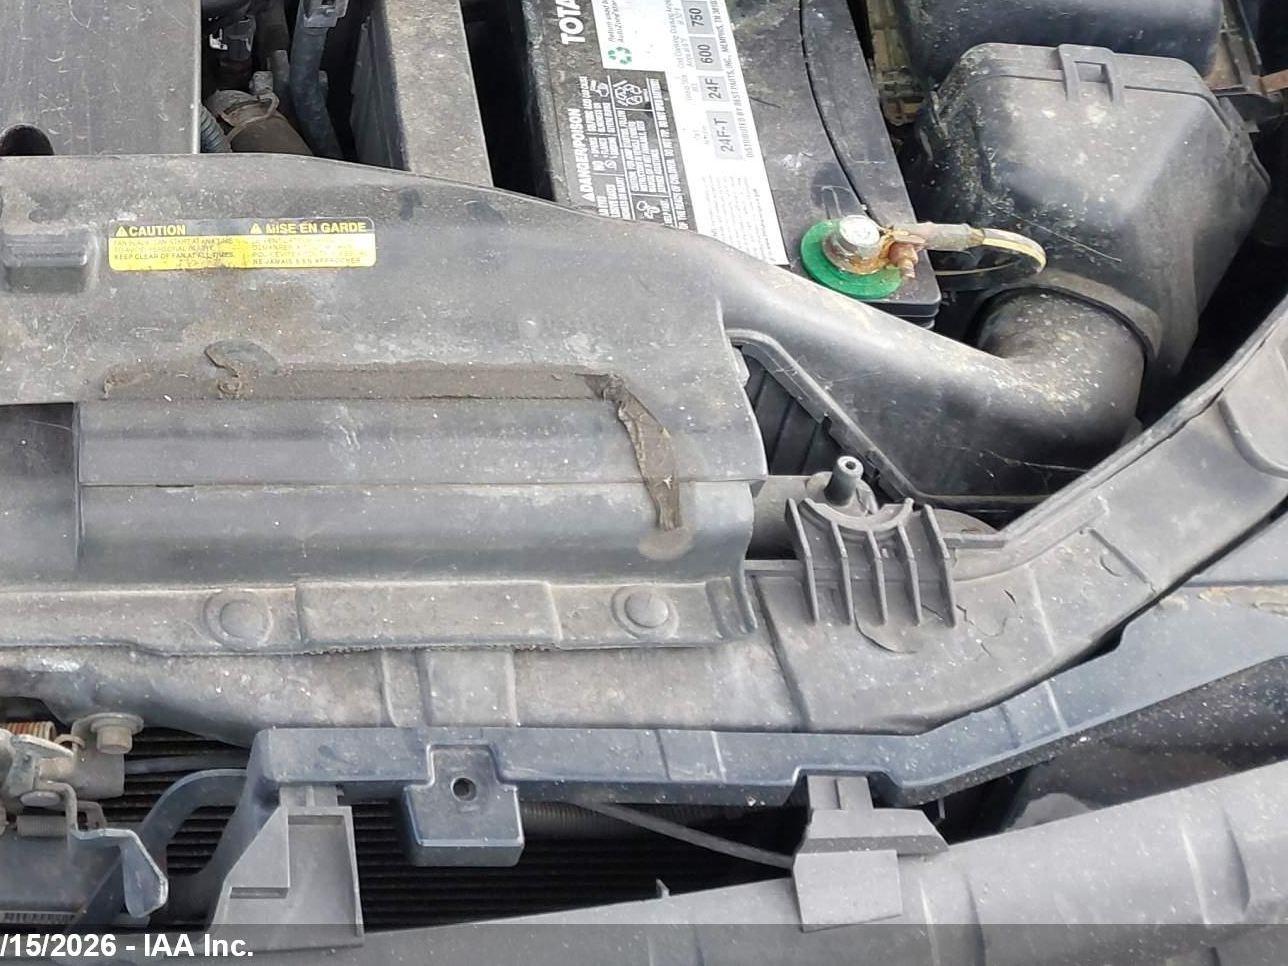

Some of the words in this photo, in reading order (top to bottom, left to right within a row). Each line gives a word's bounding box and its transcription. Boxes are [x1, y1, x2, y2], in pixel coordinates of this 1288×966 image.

[688, 8, 704, 26] 750
[696, 44, 713, 63] 600
[705, 77, 722, 99] 24F
[714, 117, 733, 152] 24F-T
[568, 107, 594, 191] DANGER/POISON
[129, 225, 186, 236] CAUTION
[266, 223, 297, 234] MISE
[299, 223, 318, 233] EN
[320, 222, 367, 233] GARDE
